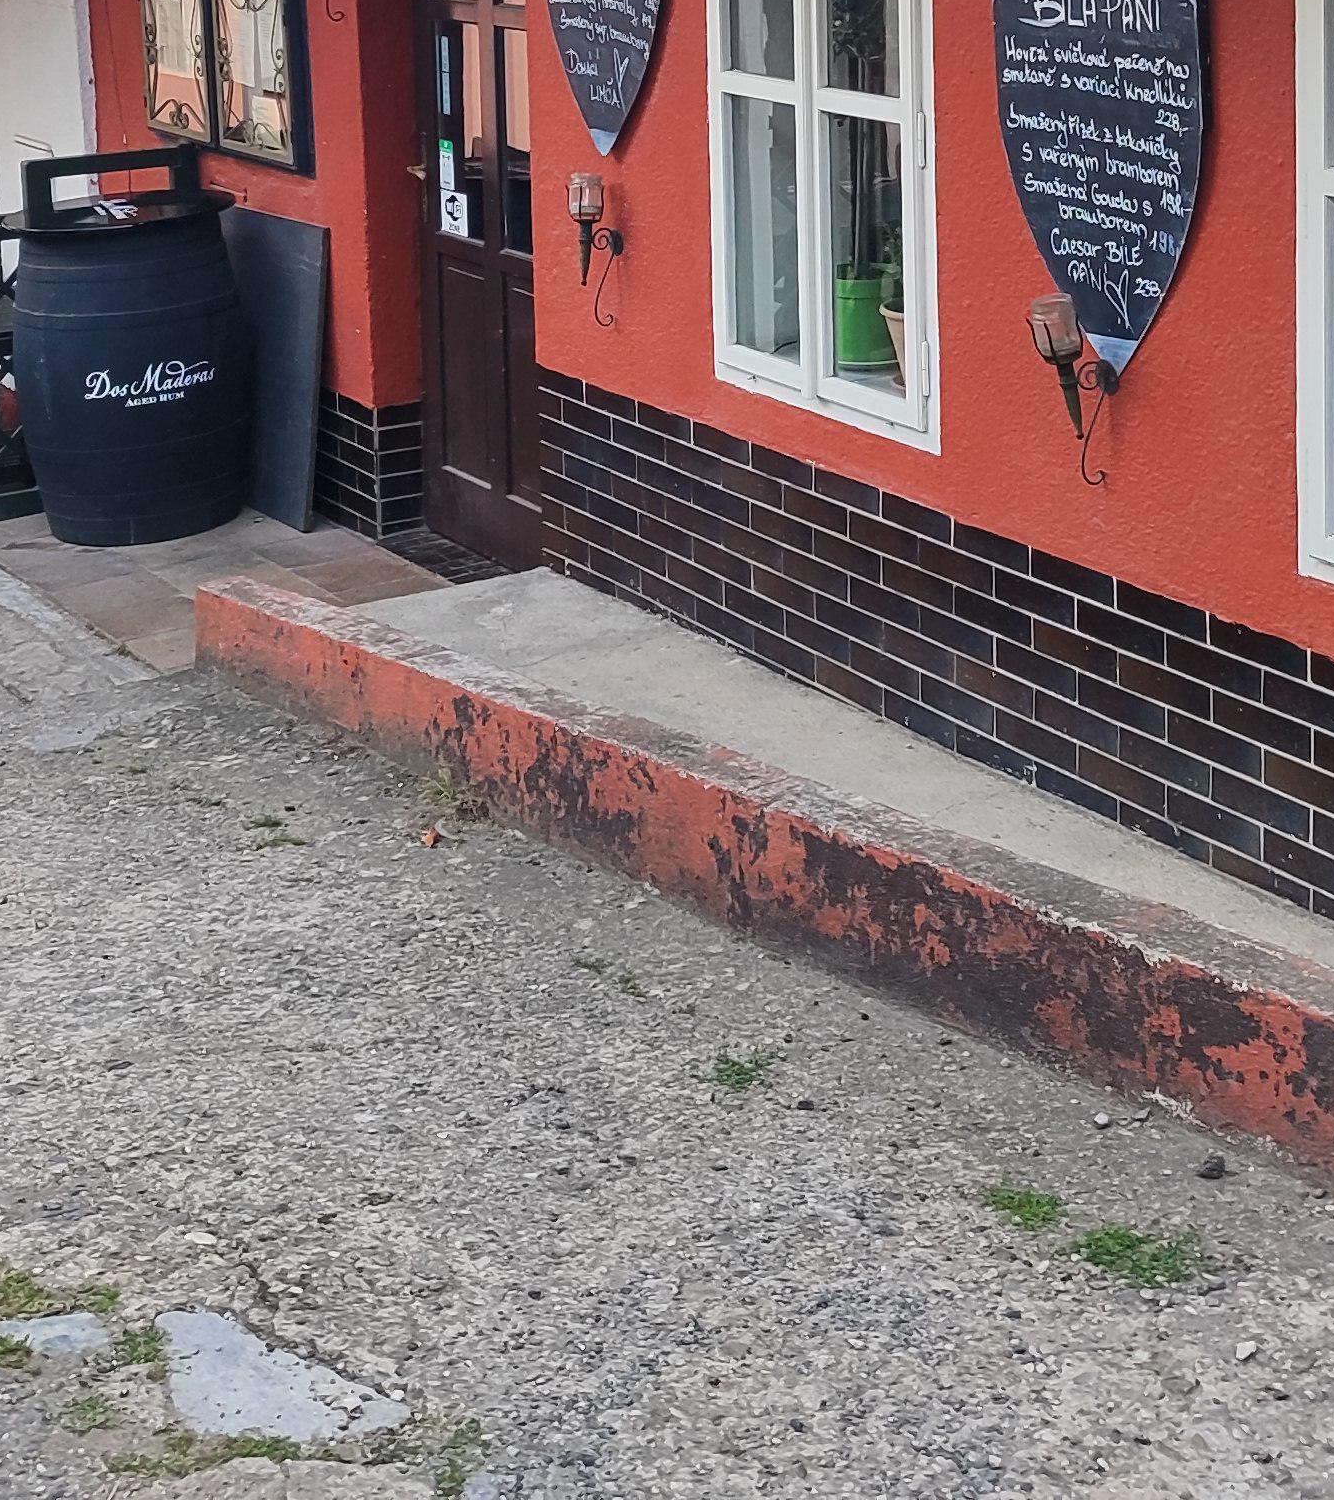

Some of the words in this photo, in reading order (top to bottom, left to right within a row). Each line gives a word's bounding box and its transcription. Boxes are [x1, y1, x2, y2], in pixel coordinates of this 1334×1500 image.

[84, 369, 129, 399] Dos
[130, 360, 215, 395] Maderas
[125, 397, 157, 408] AGED
[159, 391, 185, 402] RUM
